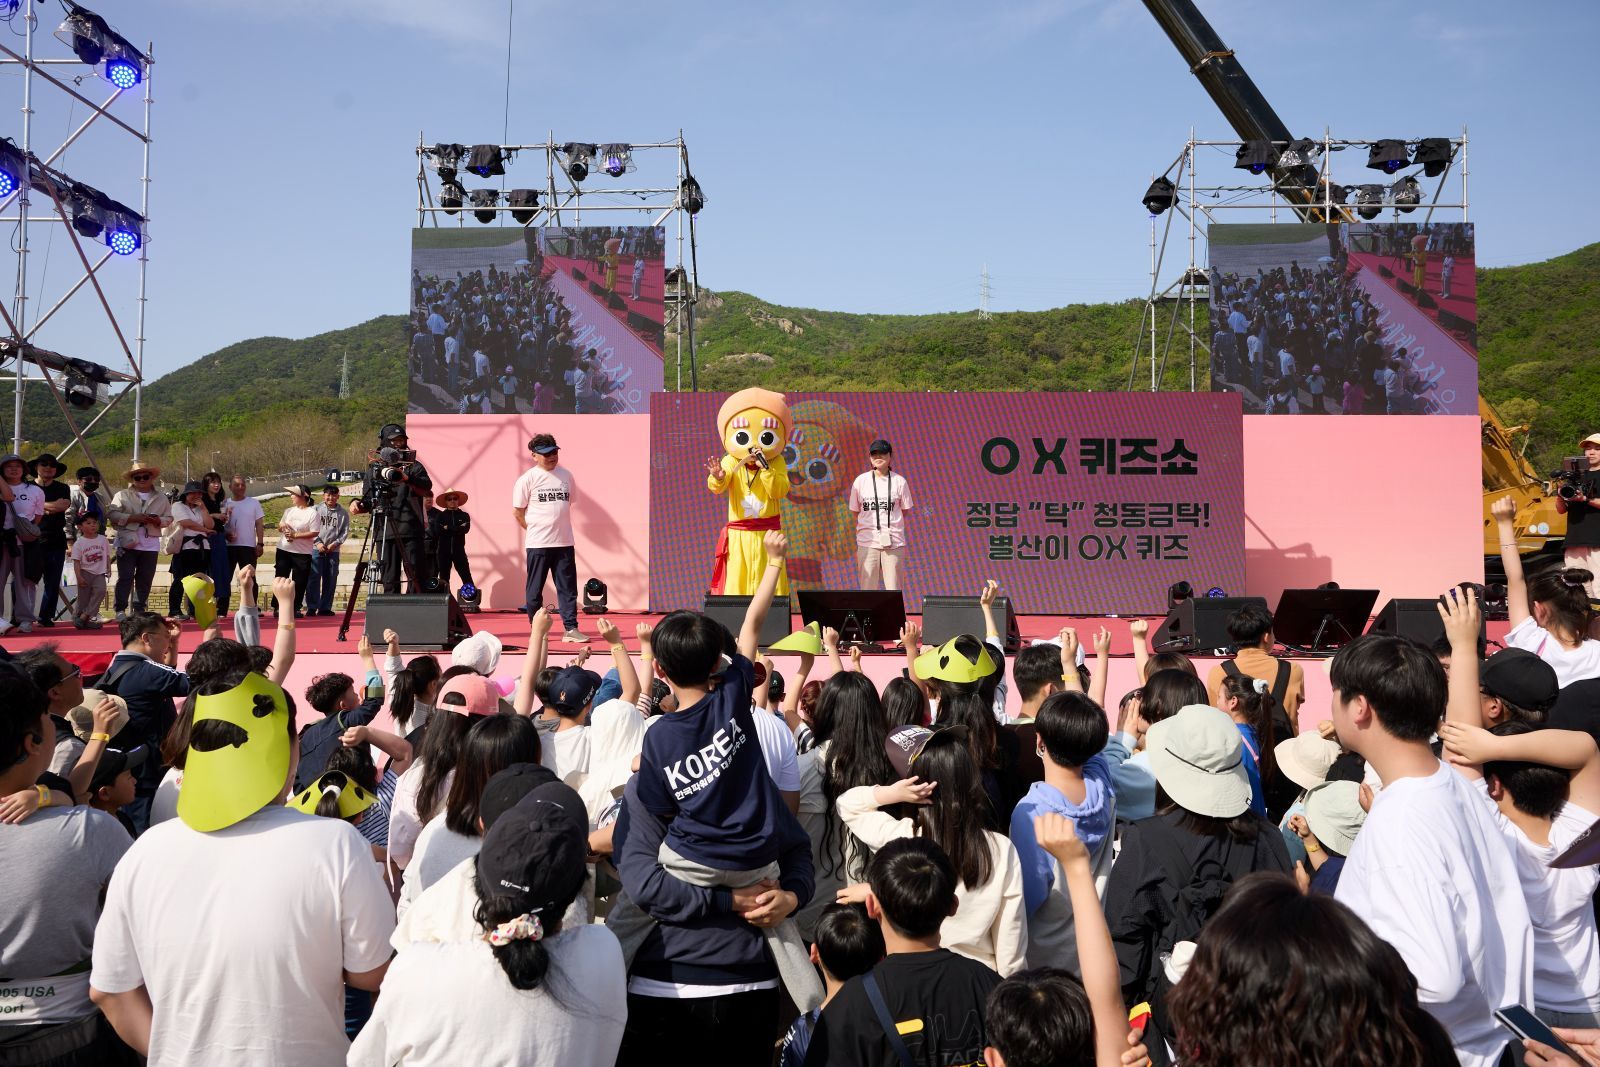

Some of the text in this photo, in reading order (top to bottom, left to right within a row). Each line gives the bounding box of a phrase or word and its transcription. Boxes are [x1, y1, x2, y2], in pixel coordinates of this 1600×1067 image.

[1079, 437, 1199, 475] 퀴즈쇼
[966, 501, 1021, 529] 정답
[1093, 501, 1211, 529] 청동금탁!
[988, 534, 1189, 561] 별산이 OX 퀴즈
[663, 717, 742, 790] KOREA
[24, 985, 56, 998] USA
